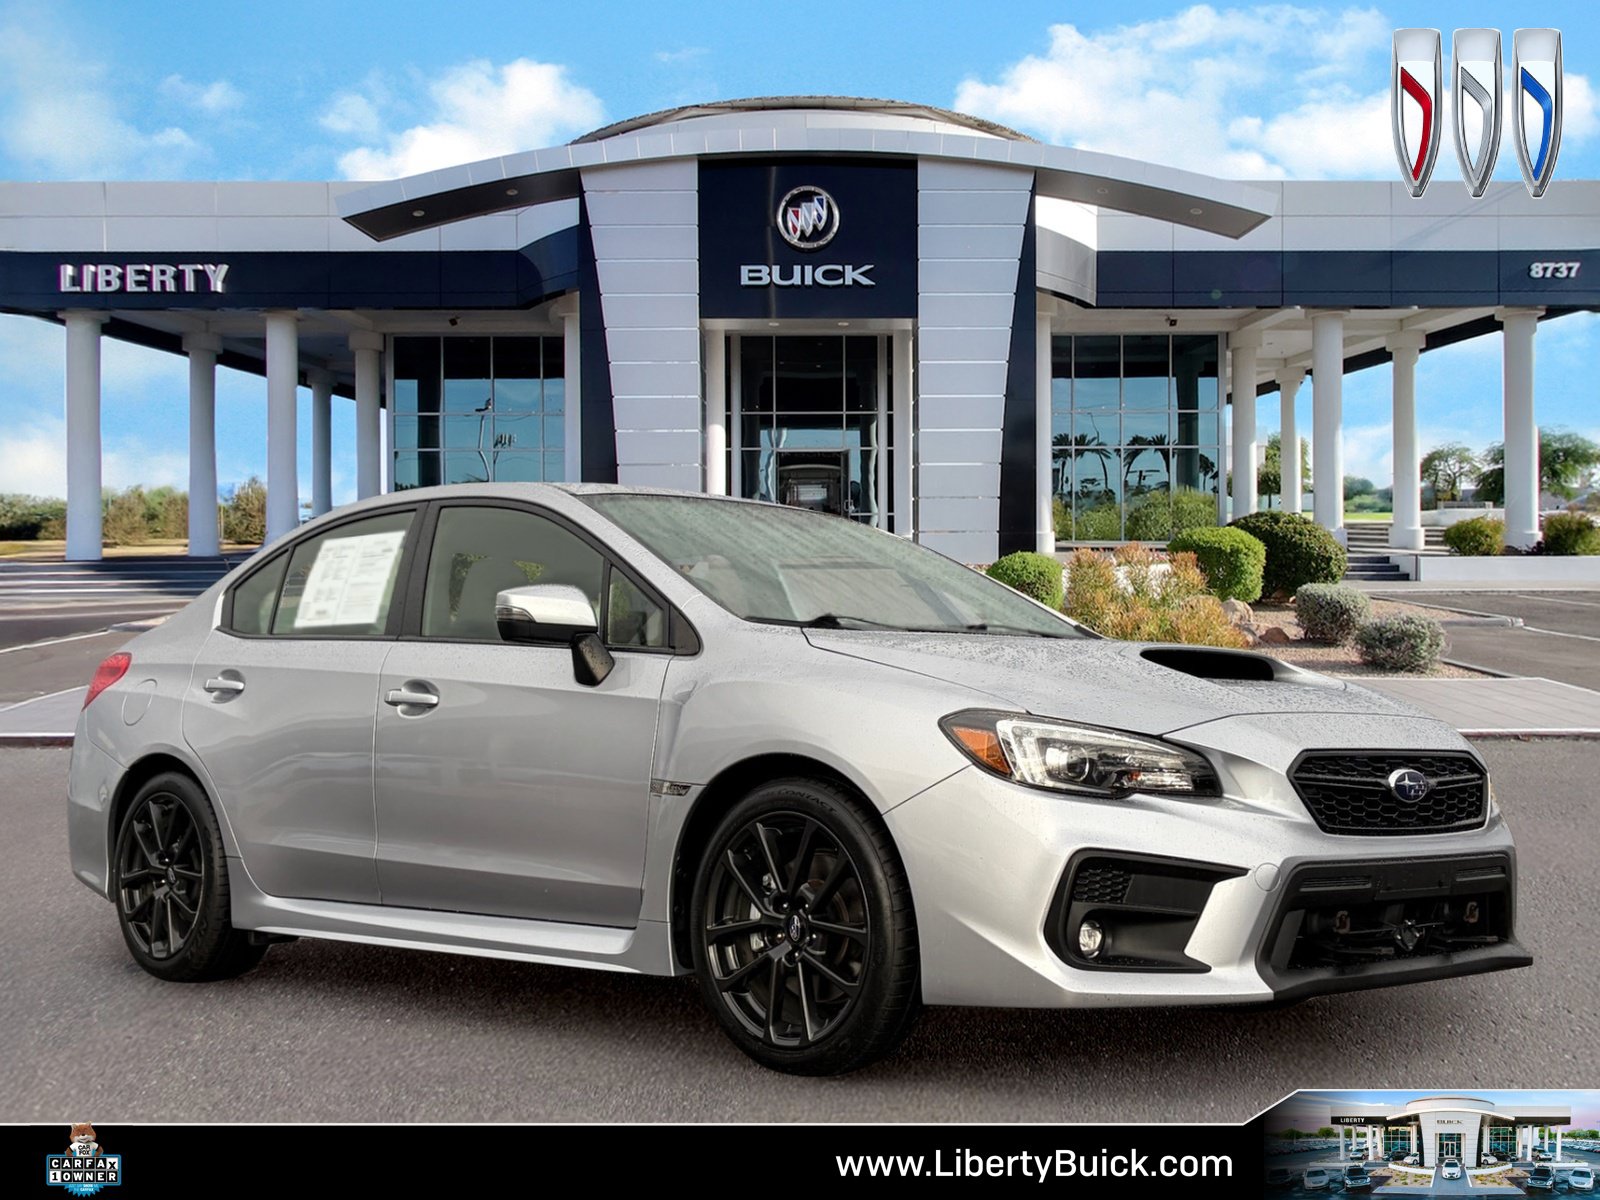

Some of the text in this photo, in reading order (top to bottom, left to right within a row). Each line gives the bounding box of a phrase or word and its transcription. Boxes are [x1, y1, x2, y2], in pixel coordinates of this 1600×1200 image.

[58, 263, 230, 293] LIBERTY
[740, 264, 876, 286] BUICK
[1529, 262, 1581, 278] 8737
